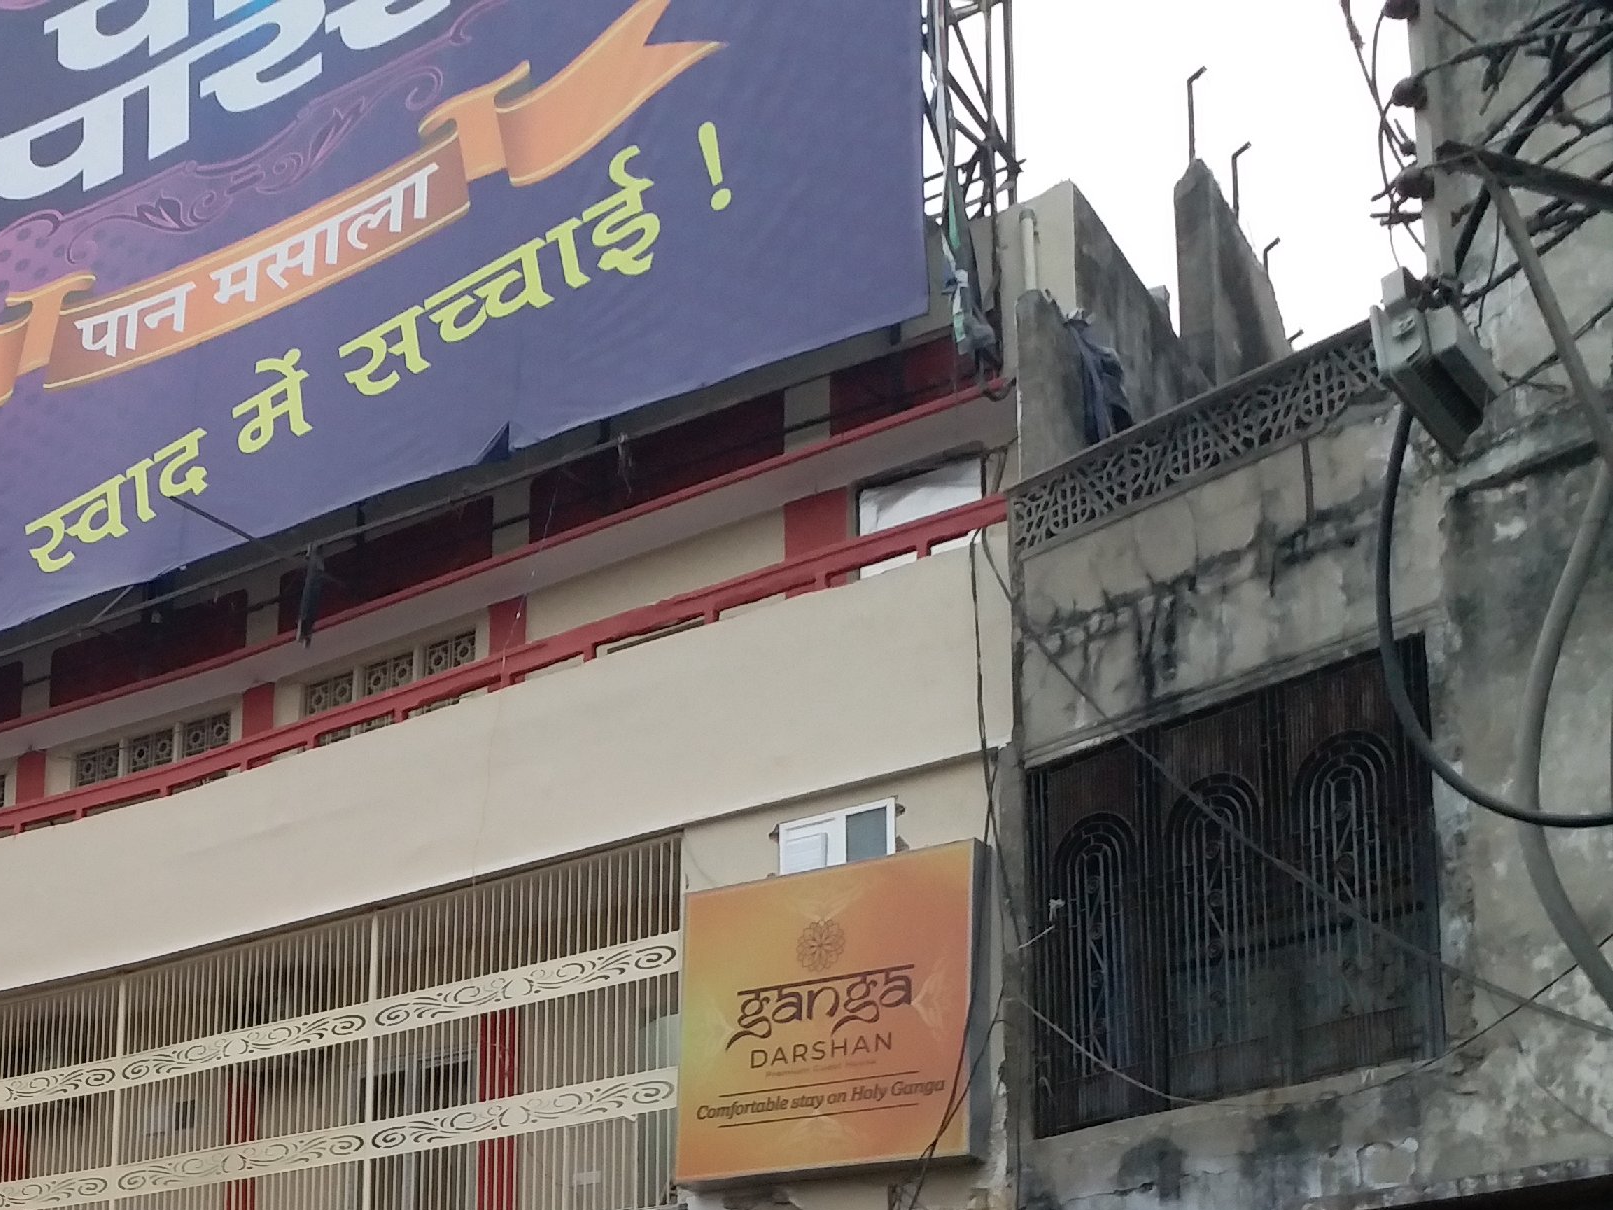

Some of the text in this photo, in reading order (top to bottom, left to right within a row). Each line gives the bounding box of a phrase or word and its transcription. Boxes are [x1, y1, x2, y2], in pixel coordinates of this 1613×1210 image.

[75, 163, 440, 358] पान मसाला
[24, 427, 208, 573] स्वाद
[231, 347, 313, 455] में
[338, 145, 662, 396] सच्चाई
[725, 963, 915, 1051] ganga
[750, 1031, 893, 1069] DARSHAN
[696, 1078, 946, 1120] Comfortable stay on Holy Ganga
